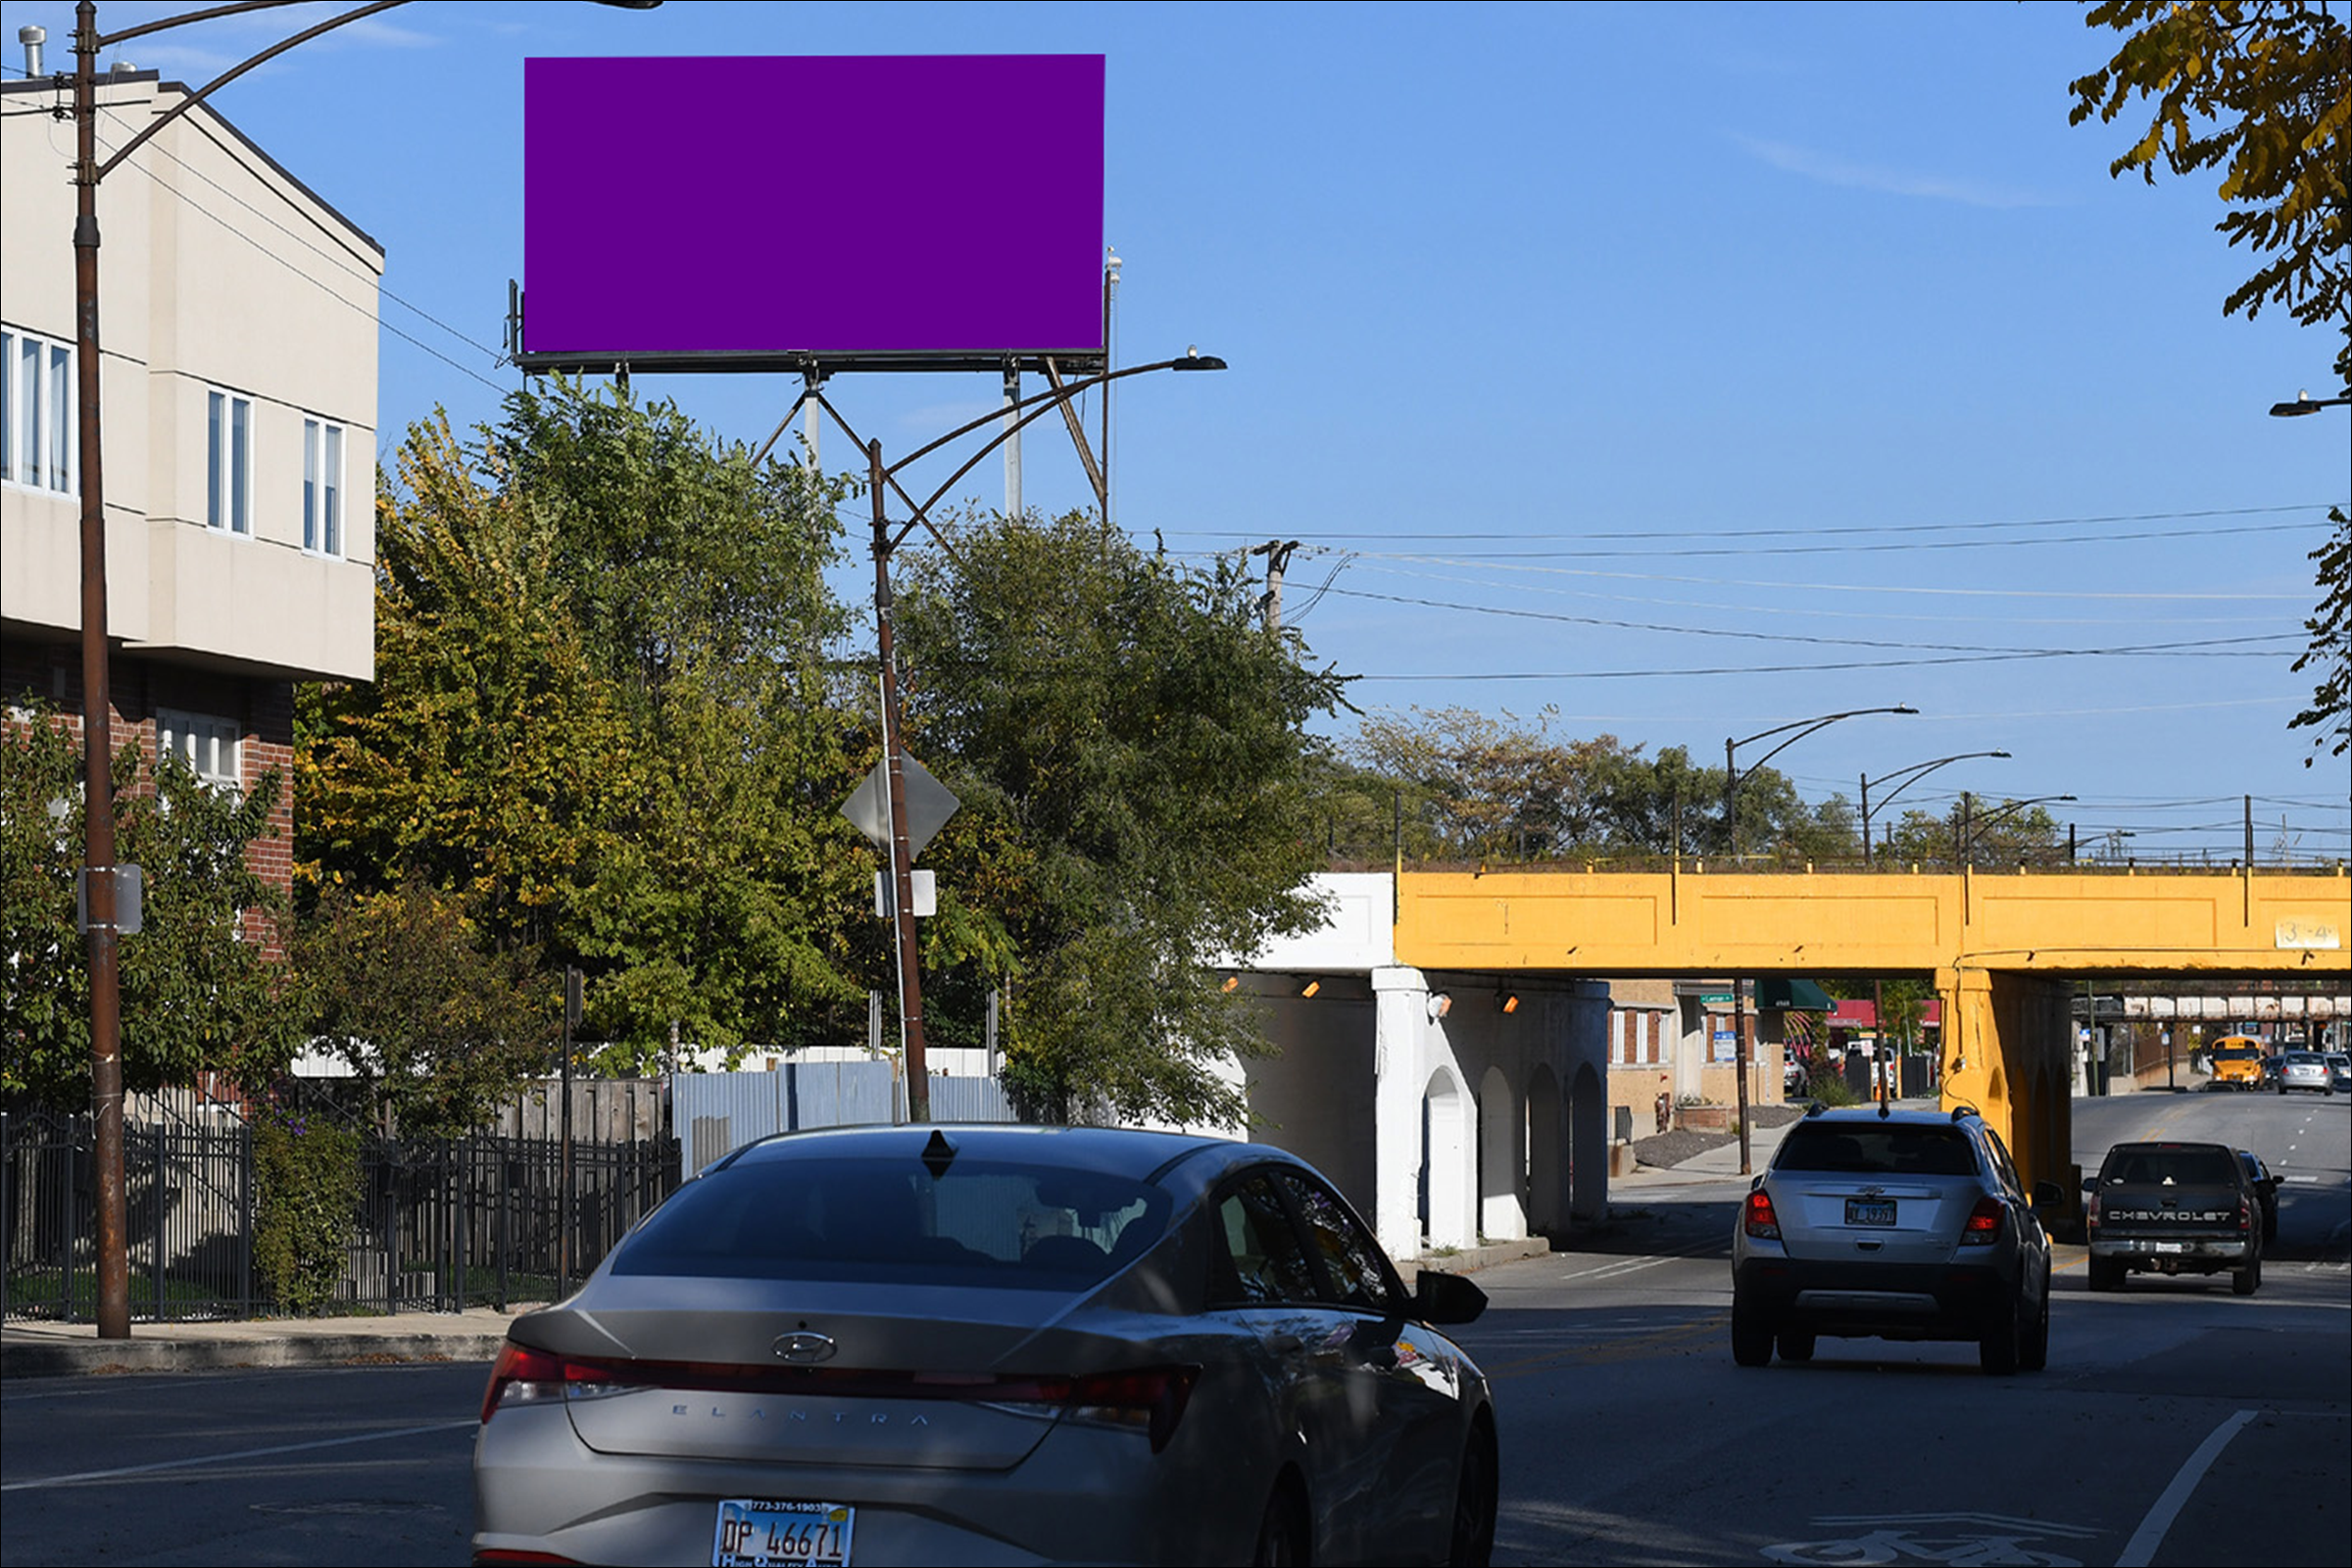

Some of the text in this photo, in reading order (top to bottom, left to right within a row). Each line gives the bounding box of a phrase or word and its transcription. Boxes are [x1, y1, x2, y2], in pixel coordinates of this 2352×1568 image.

[2108, 1210, 2230, 1221] CHEVROLET
[672, 1404, 929, 1426] ELANTRA
[753, 1501, 821, 1513] 773-376-1903
[722, 1519, 843, 1558] DP 46671
